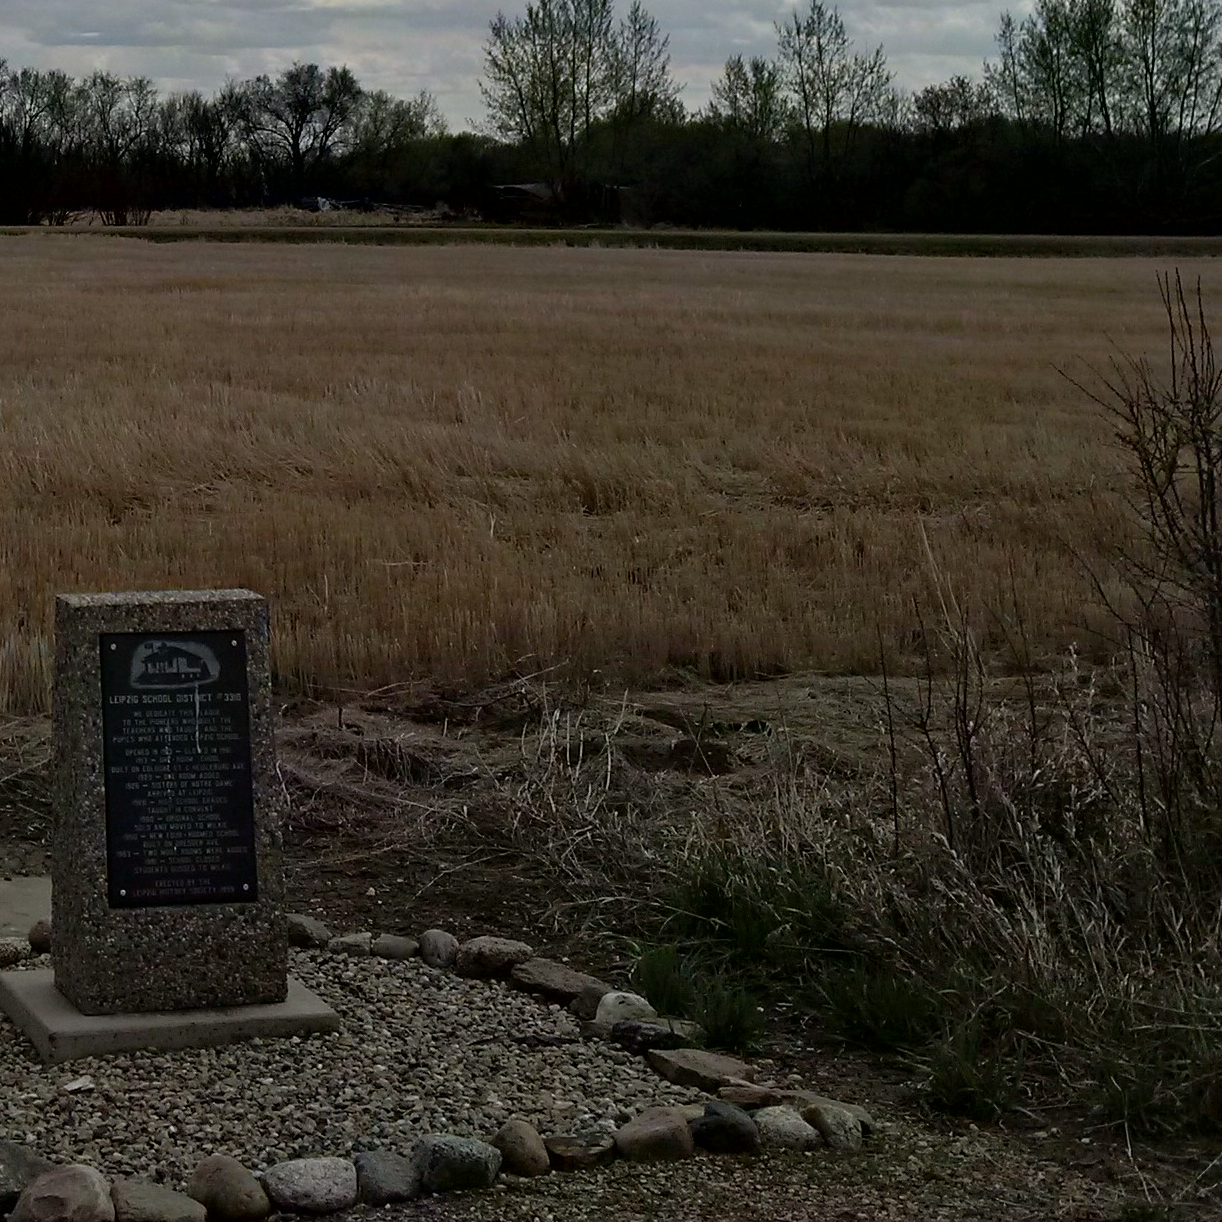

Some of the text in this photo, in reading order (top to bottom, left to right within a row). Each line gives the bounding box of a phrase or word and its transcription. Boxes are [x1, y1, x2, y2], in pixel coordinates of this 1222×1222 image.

[109, 695, 139, 704] LEIPZIG
[142, 695, 172, 703] SCHOOL
[176, 694, 212, 703] DISTICT
